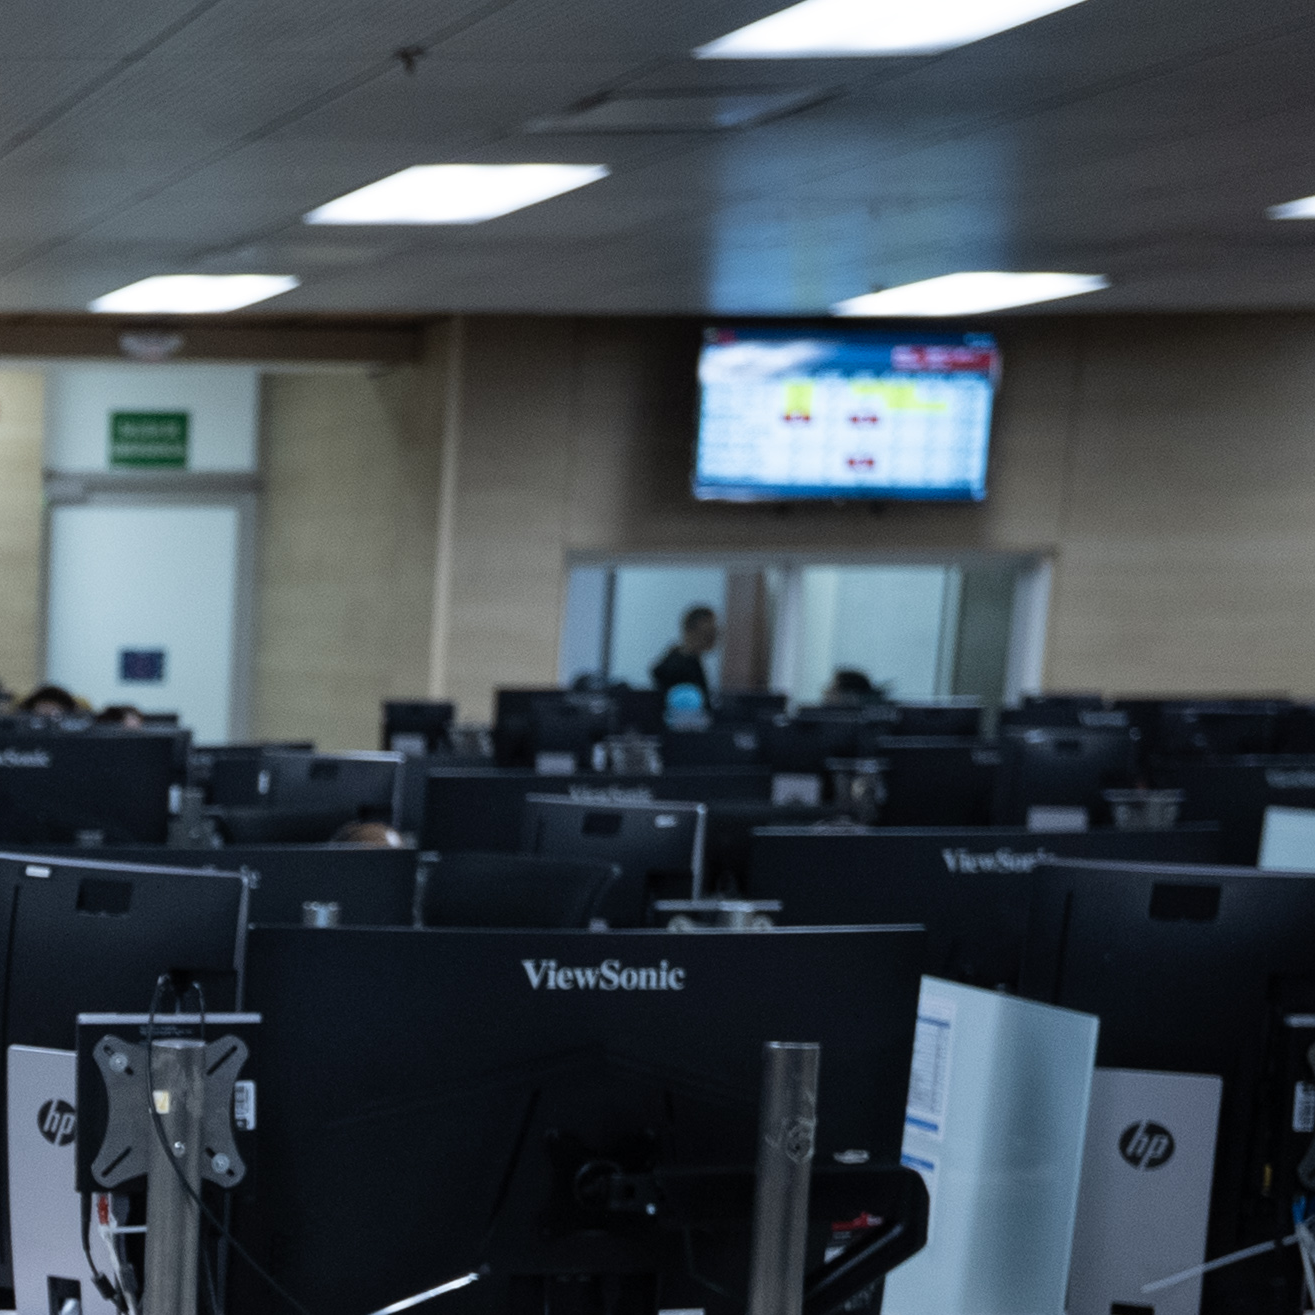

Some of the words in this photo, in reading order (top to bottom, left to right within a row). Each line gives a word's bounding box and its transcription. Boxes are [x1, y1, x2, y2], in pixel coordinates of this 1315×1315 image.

[522, 958, 685, 990] ViewSonic
[40, 1099, 76, 1146] hp
[1121, 1120, 1173, 1171] hp
